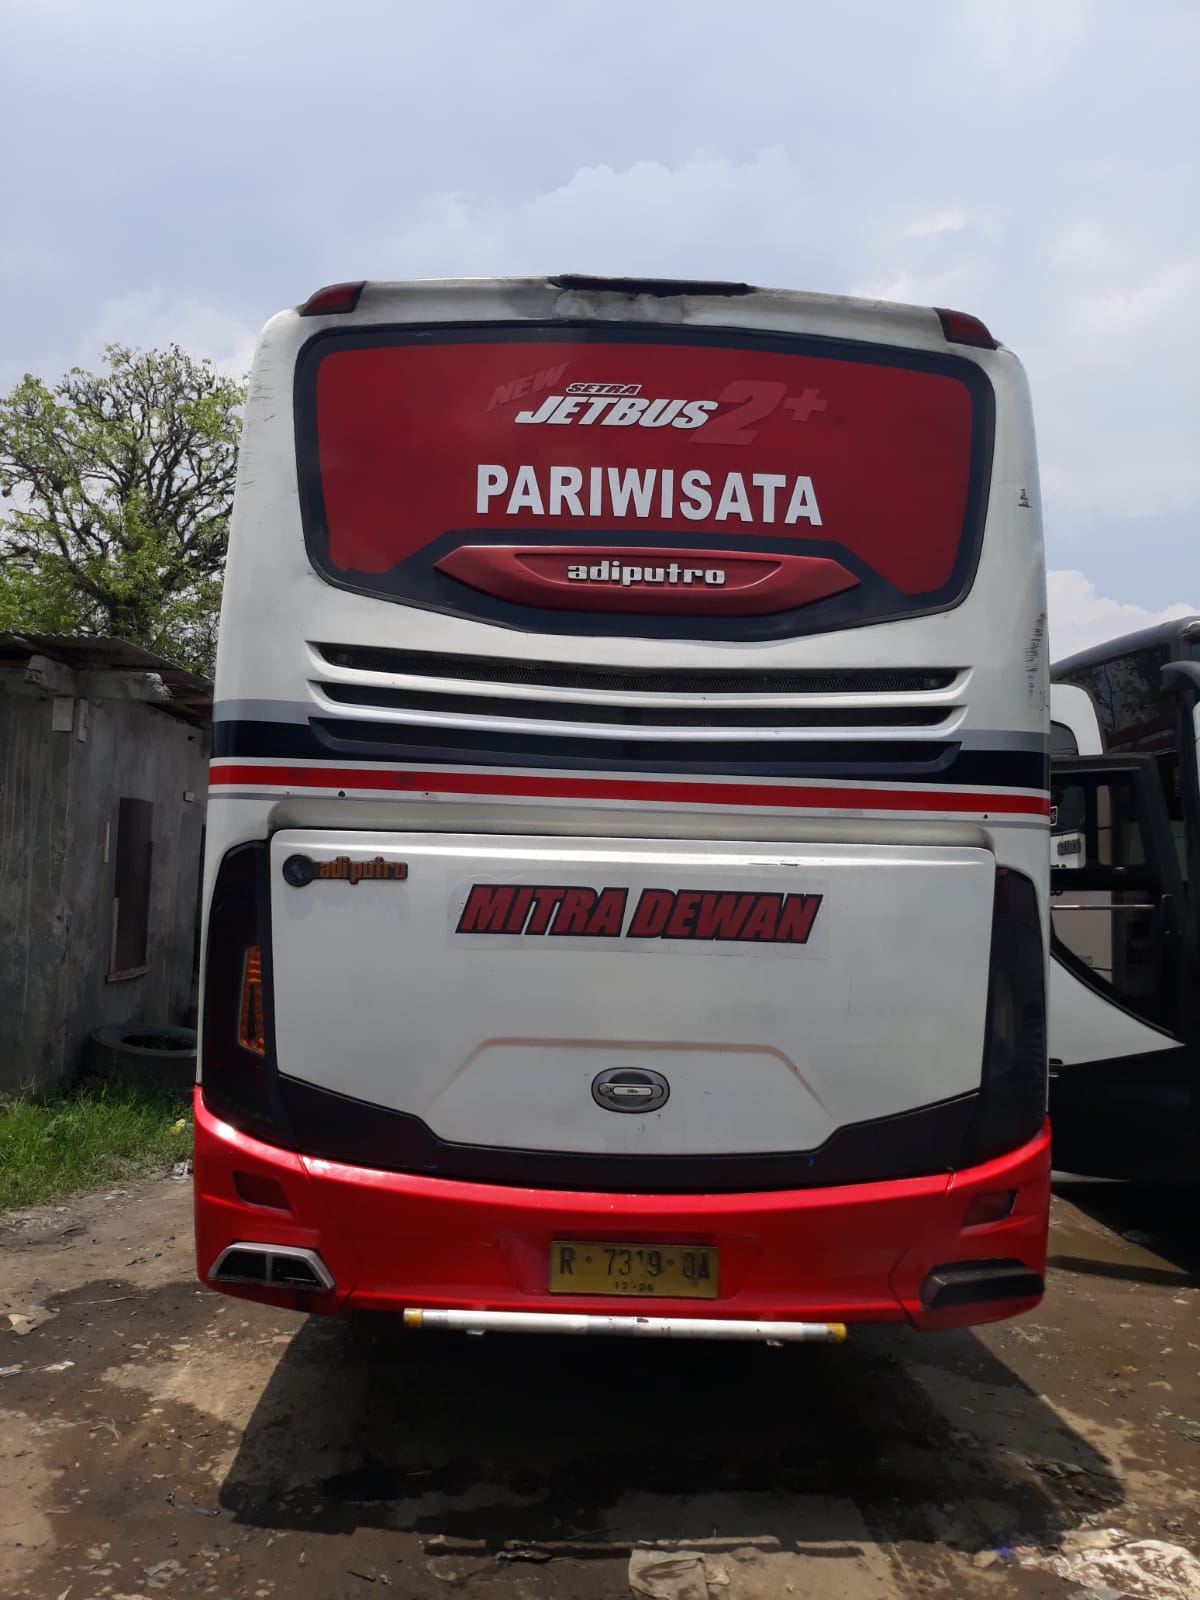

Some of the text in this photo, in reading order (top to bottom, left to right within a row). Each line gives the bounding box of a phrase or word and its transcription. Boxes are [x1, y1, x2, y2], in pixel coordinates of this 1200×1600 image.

[487, 363, 569, 412] NEW
[566, 382, 642, 395] SETRA
[514, 396, 718, 429] JETBUS
[476, 464, 823, 526] PARIWISATA
[567, 560, 726, 587] adiputro
[455, 884, 824, 944] MITRA DEWAN
[559, 1247, 575, 1275] R
